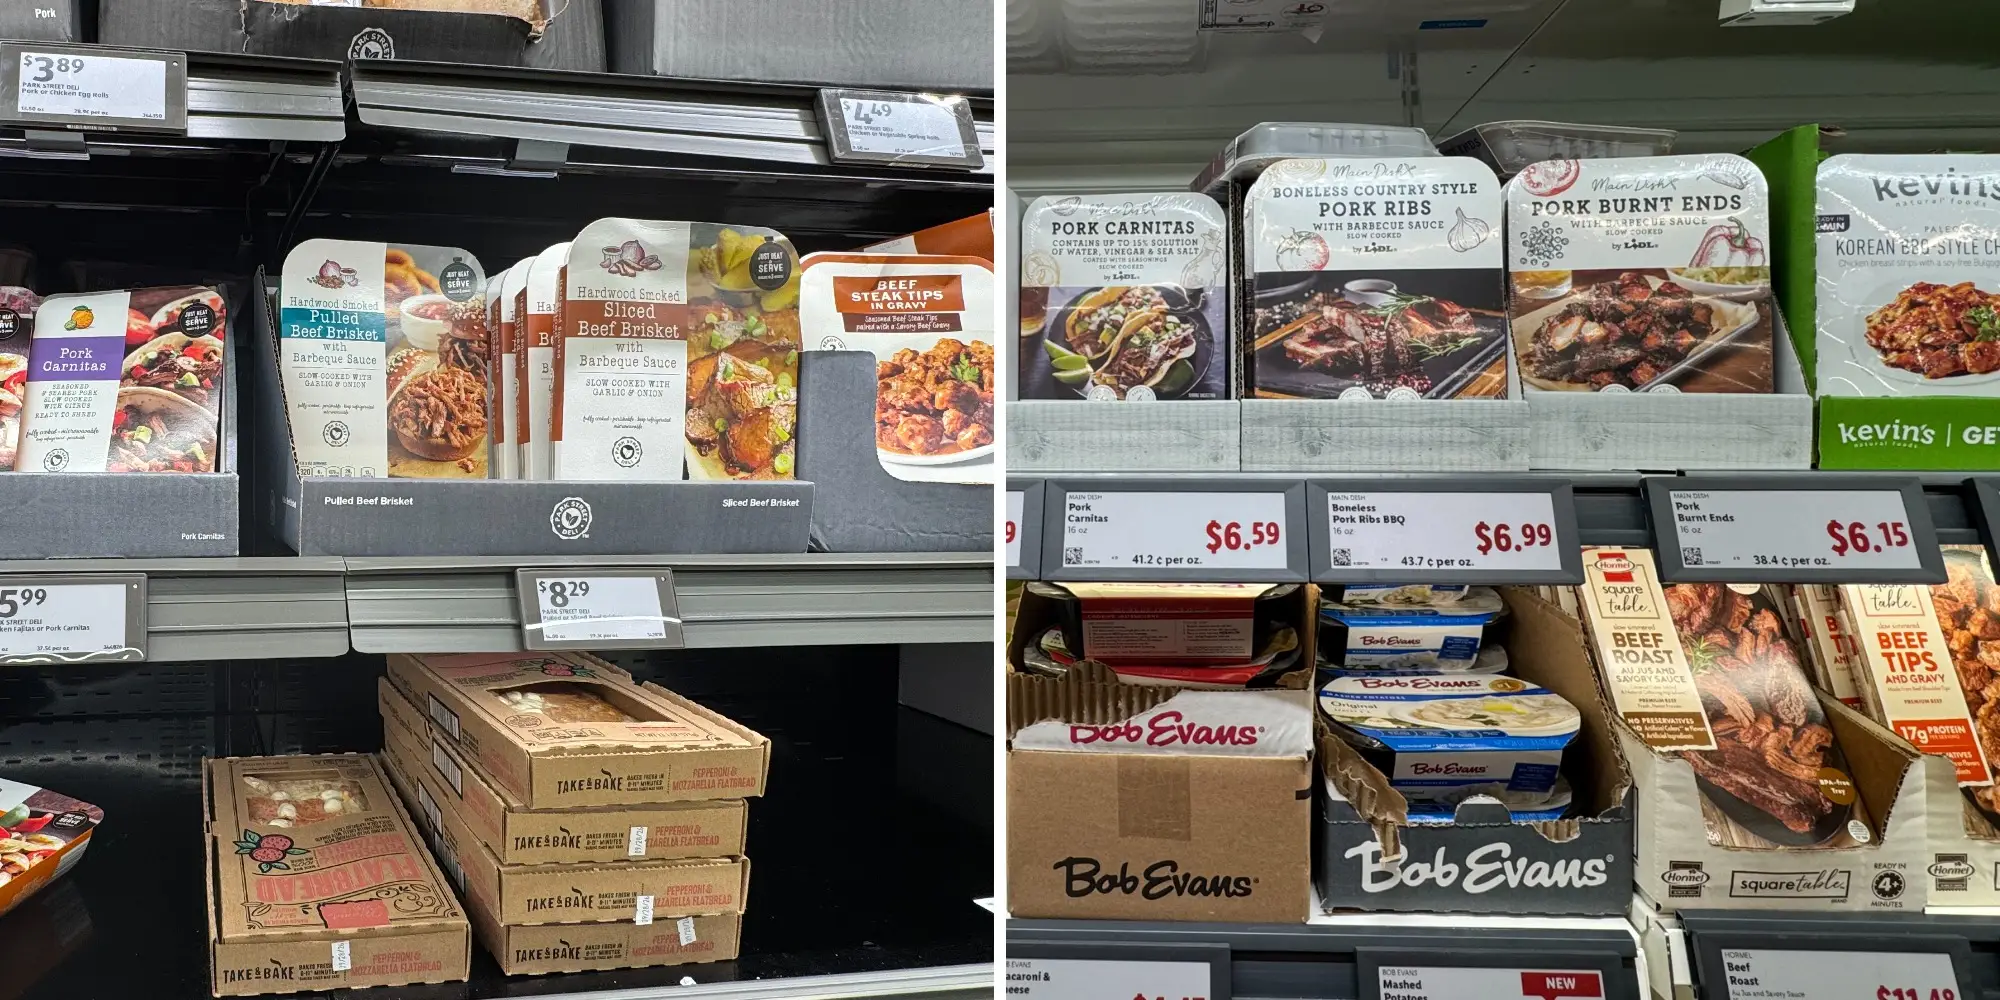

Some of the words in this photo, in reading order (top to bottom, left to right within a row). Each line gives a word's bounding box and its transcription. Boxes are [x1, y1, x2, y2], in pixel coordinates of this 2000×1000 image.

[35, 8, 56, 18] Pork
[1273, 185, 1348, 198] BONELESS
[1354, 184, 1426, 196] COUNTRY
[1431, 183, 1477, 195] STYLE
[1319, 201, 1377, 217] PORK
[1384, 201, 1431, 216] RIBS
[1532, 200, 1590, 216] PORK
[1599, 198, 1673, 214] BURNT
[1681, 194, 1742, 211] ENDS
[1052, 222, 1099, 236] PORK
[1105, 221, 1194, 235] CARNITAS
[1313, 222, 1343, 231] WITH
[1347, 221, 1405, 231] BARBECUE
[1408, 220, 1444, 229] SAUCE
[1052, 239, 1100, 247] CONTAINS
[1103, 239, 1115, 247] UP
[1117, 239, 1130, 247] TO
[1133, 239, 1148, 247] 15%
[1836, 239, 1895, 256] KOREAN
[1052, 248, 1064, 256] OF
[1067, 248, 1101, 256] WATER,
[877, 280, 917, 291] BEEF
[577, 286, 636, 299] Hardwood
[640, 288, 680, 302] Smoked
[851, 291, 903, 302] STEAK
[906, 290, 944, 301] TIPS
[290, 297, 339, 309] Hardwood
[343, 300, 379, 311] Smoked
[871, 302, 883, 310] IN
[887, 301, 927, 310] GRAVY
[604, 302, 655, 319] Sliced
[310, 310, 359, 325] Pulled
[892, 315, 907, 323] Beef
[291, 325, 323, 338] Beef
[326, 327, 378, 340] Brisket
[577, 321, 618, 337] Beef
[620, 321, 679, 339] Brisket
[323, 342, 347, 352] with
[616, 341, 643, 352] with
[60, 348, 93, 359] Pork
[293, 353, 343, 365] Barbeque
[347, 355, 377, 365] Sauce
[43, 361, 106, 372] Carnitas
[579, 355, 639, 369] Barbeque
[643, 357, 677, 369] Sauce
[585, 379, 609, 387] SLOW
[611, 379, 646, 388] COOKED
[649, 380, 670, 388] WITH
[592, 388, 626, 396] GARLIC
[637, 389, 663, 397] ONION
[1837, 419, 1936, 444] kevin's
[325, 497, 354, 505] Pulled
[357, 497, 378, 505] Beef
[380, 497, 413, 506] Brisket
[722, 499, 748, 508] Sliced
[750, 499, 769, 507] Beef
[770, 499, 800, 507] Brisket
[1068, 503, 1091, 512] Pork
[1332, 503, 1377, 512] Boneless
[1675, 502, 1700, 511] Pork
[555, 502, 570, 522] PARK
[571, 501, 588, 522] STREET
[1678, 513, 1708, 522] Burnt
[1709, 513, 1735, 522] Ends
[1068, 514, 1108, 523] Carnitas
[1333, 515, 1356, 524] Pork
[1358, 515, 1381, 524] Ribs
[1383, 515, 1405, 526] BBQ
[1068, 526, 1077, 534] 16
[1333, 527, 1342, 535] 16
[1680, 526, 1690, 534] 16
[1205, 519, 1280, 554] $6.59
[1474, 520, 1552, 555] $6.99
[1826, 519, 1908, 556] $6.15
[1132, 555, 1153, 565] 41.2
[1156, 556, 1162, 565] ¢
[1165, 556, 1183, 567] per
[1186, 556, 1203, 565] oz.
[1401, 556, 1424, 566] 43.7
[1427, 557, 1433, 567] ¢
[1436, 558, 1455, 568] per
[1458, 558, 1475, 566] oz.
[1753, 555, 1779, 565] 38.4
[1781, 556, 1789, 566] ¢
[1791, 557, 1810, 567] per
[1814, 556, 1832, 566] oz.
[1602, 586, 1643, 597] square
[1606, 595, 1648, 614] table
[1870, 588, 1912, 611] table
[13, 625, 36, 633] Fajitas
[1612, 632, 1664, 648] BEEF
[1877, 632, 1928, 650] BEEF
[1612, 650, 1674, 664] ROAST
[1881, 652, 1938, 673] TIPS
[1353, 677, 1409, 689] Bob
[1413, 679, 1481, 689] Evans
[1885, 675, 1908, 684] AND
[1910, 674, 1945, 685] GRAVY
[1146, 711, 1258, 746] Evans
[1900, 726, 1929, 744] 17g
[1927, 726, 1966, 734] PROTEIN
[692, 766, 729, 778] PEPPERONI
[557, 779, 584, 794] TAKE
[594, 777, 624, 791] BAKE
[672, 778, 717, 790] MOZZARELLA
[717, 774, 756, 789] FLATBREAD
[1345, 840, 1459, 893] Bob
[1462, 842, 1607, 894] Evans
[1053, 857, 1140, 897] Bob
[1141, 860, 1252, 900] Evans
[1667, 872, 1705, 884] Hormel
[1727, 963, 1750, 973] Beef
[1383, 980, 1422, 989] Mashed
[1546, 978, 1576, 989] NEW
[1729, 976, 1759, 987] Roast
